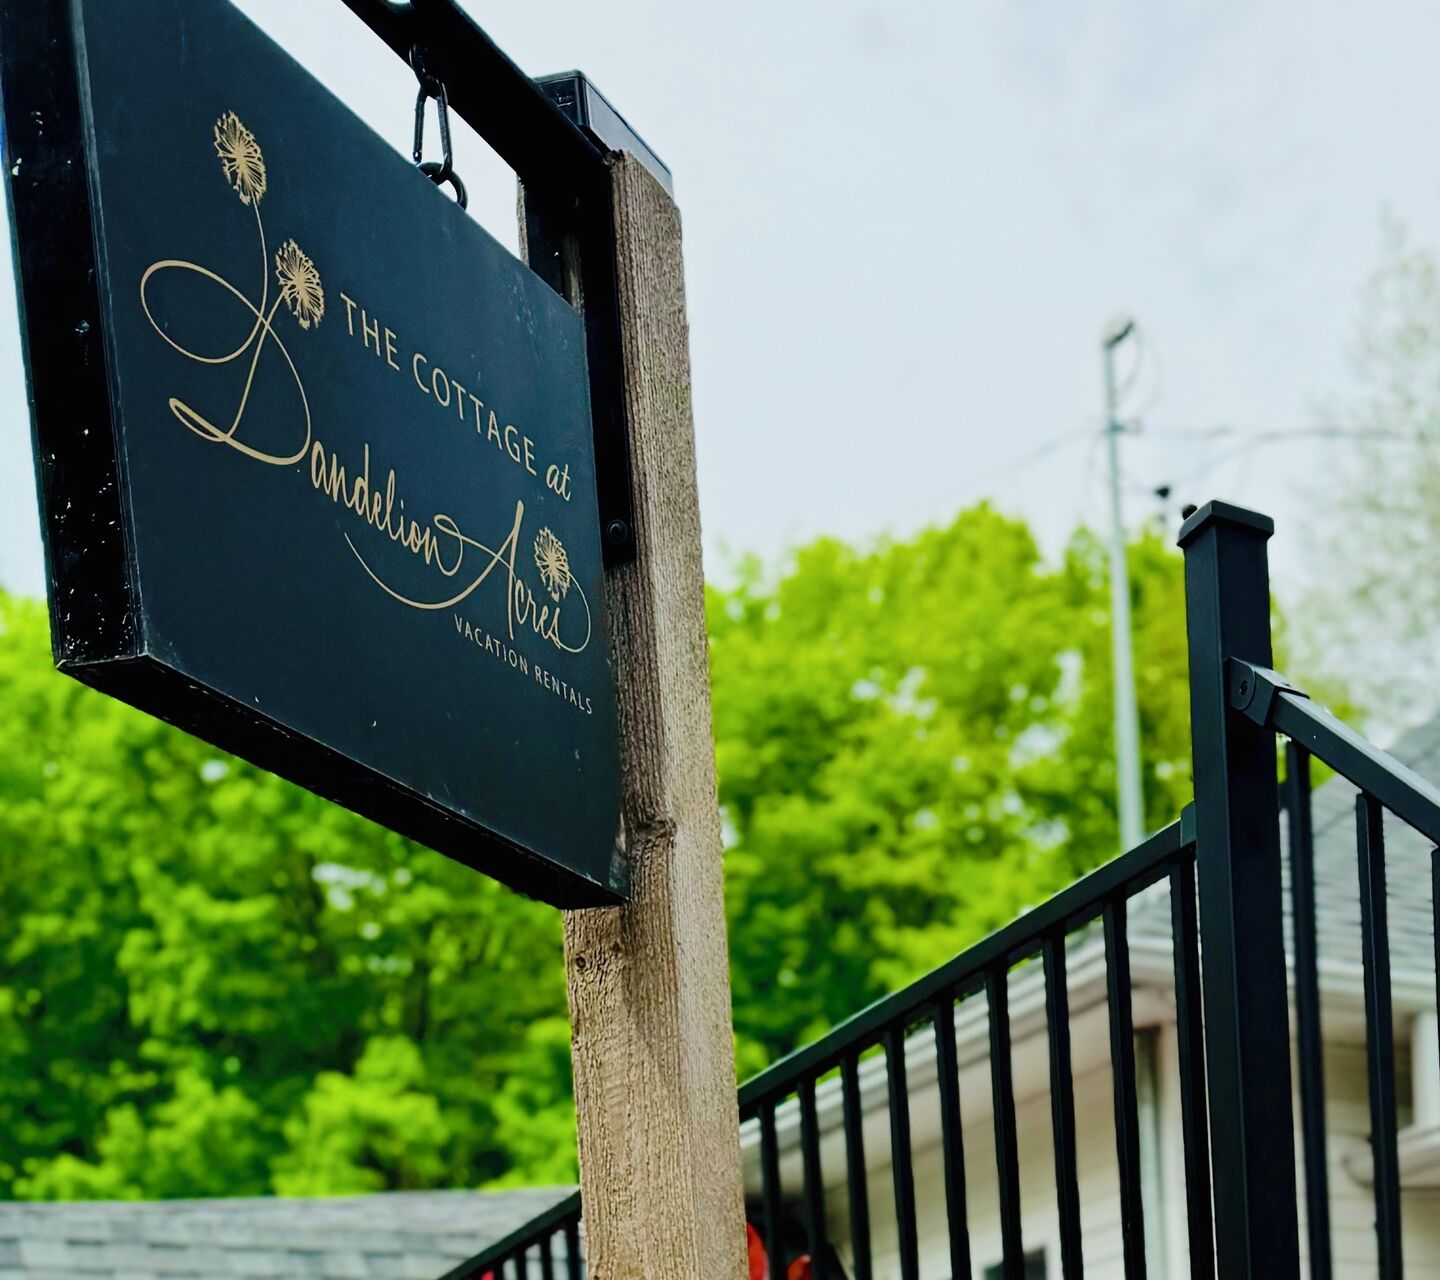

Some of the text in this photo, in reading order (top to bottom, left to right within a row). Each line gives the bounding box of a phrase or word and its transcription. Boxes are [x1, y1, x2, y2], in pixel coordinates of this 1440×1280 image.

[141, 259, 464, 577] Dandelion
[340, 292, 571, 502] THE COTTAGE at
[453, 613, 593, 716] VACATION RENTALS
